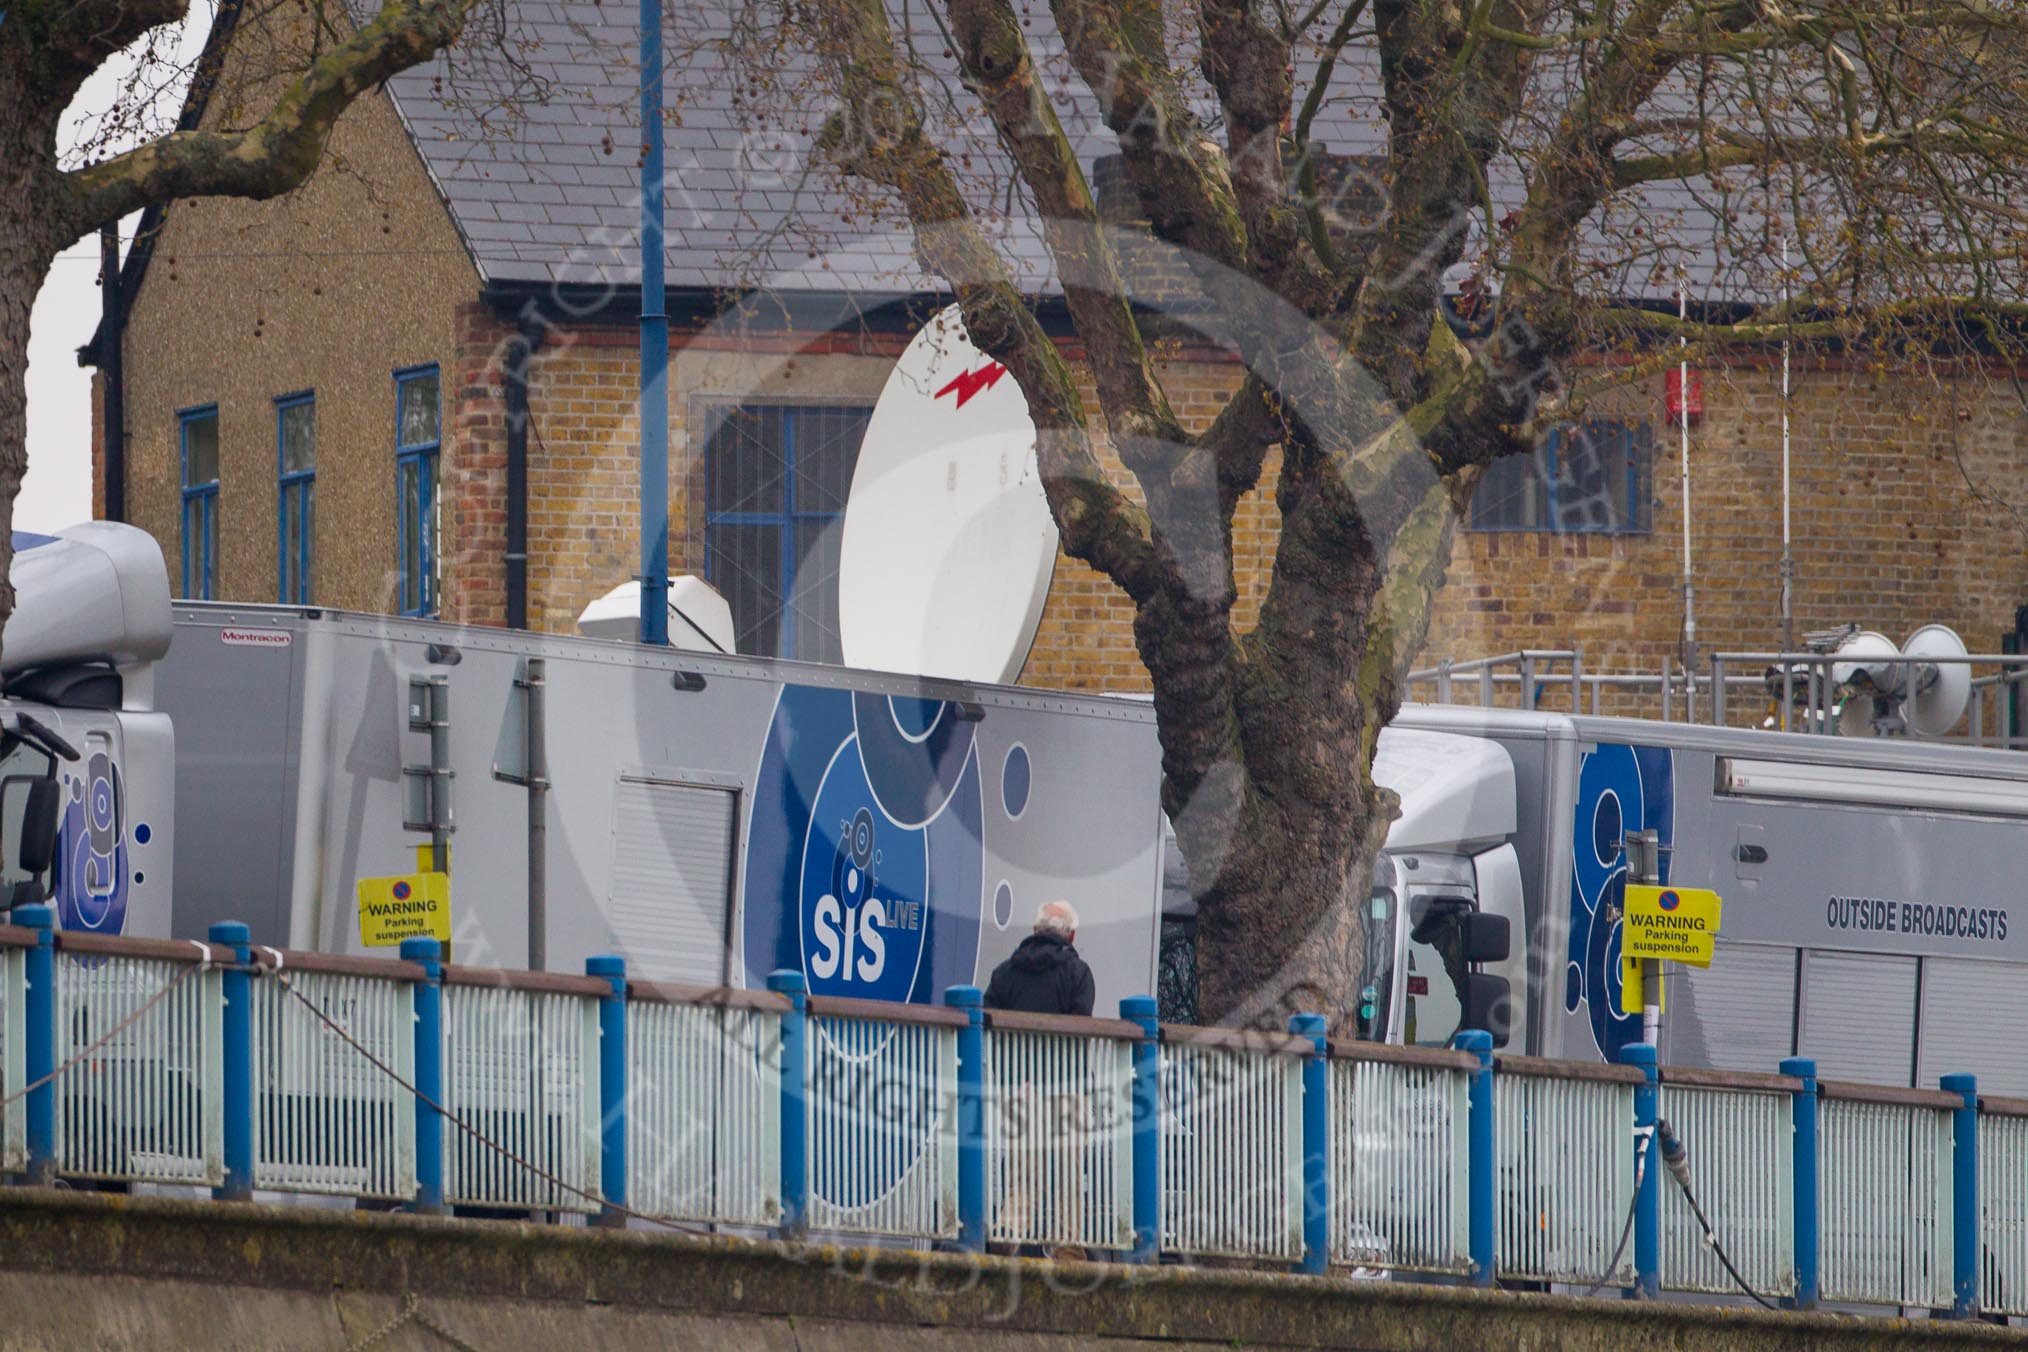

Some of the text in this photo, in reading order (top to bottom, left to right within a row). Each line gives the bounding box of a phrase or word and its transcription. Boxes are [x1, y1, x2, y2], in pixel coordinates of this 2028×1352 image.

[222, 631, 290, 643] Montracon
[368, 900, 437, 917] WARNING
[885, 899, 919, 931] LIVE
[384, 917, 424, 928] Parking
[1630, 913, 1705, 930] WARNING
[1827, 897, 2008, 941] OUTSIDE BROADCASTS
[376, 928, 435, 940] suspension
[1645, 929, 1689, 943] Parking
[1633, 942, 1699, 954] suspension
